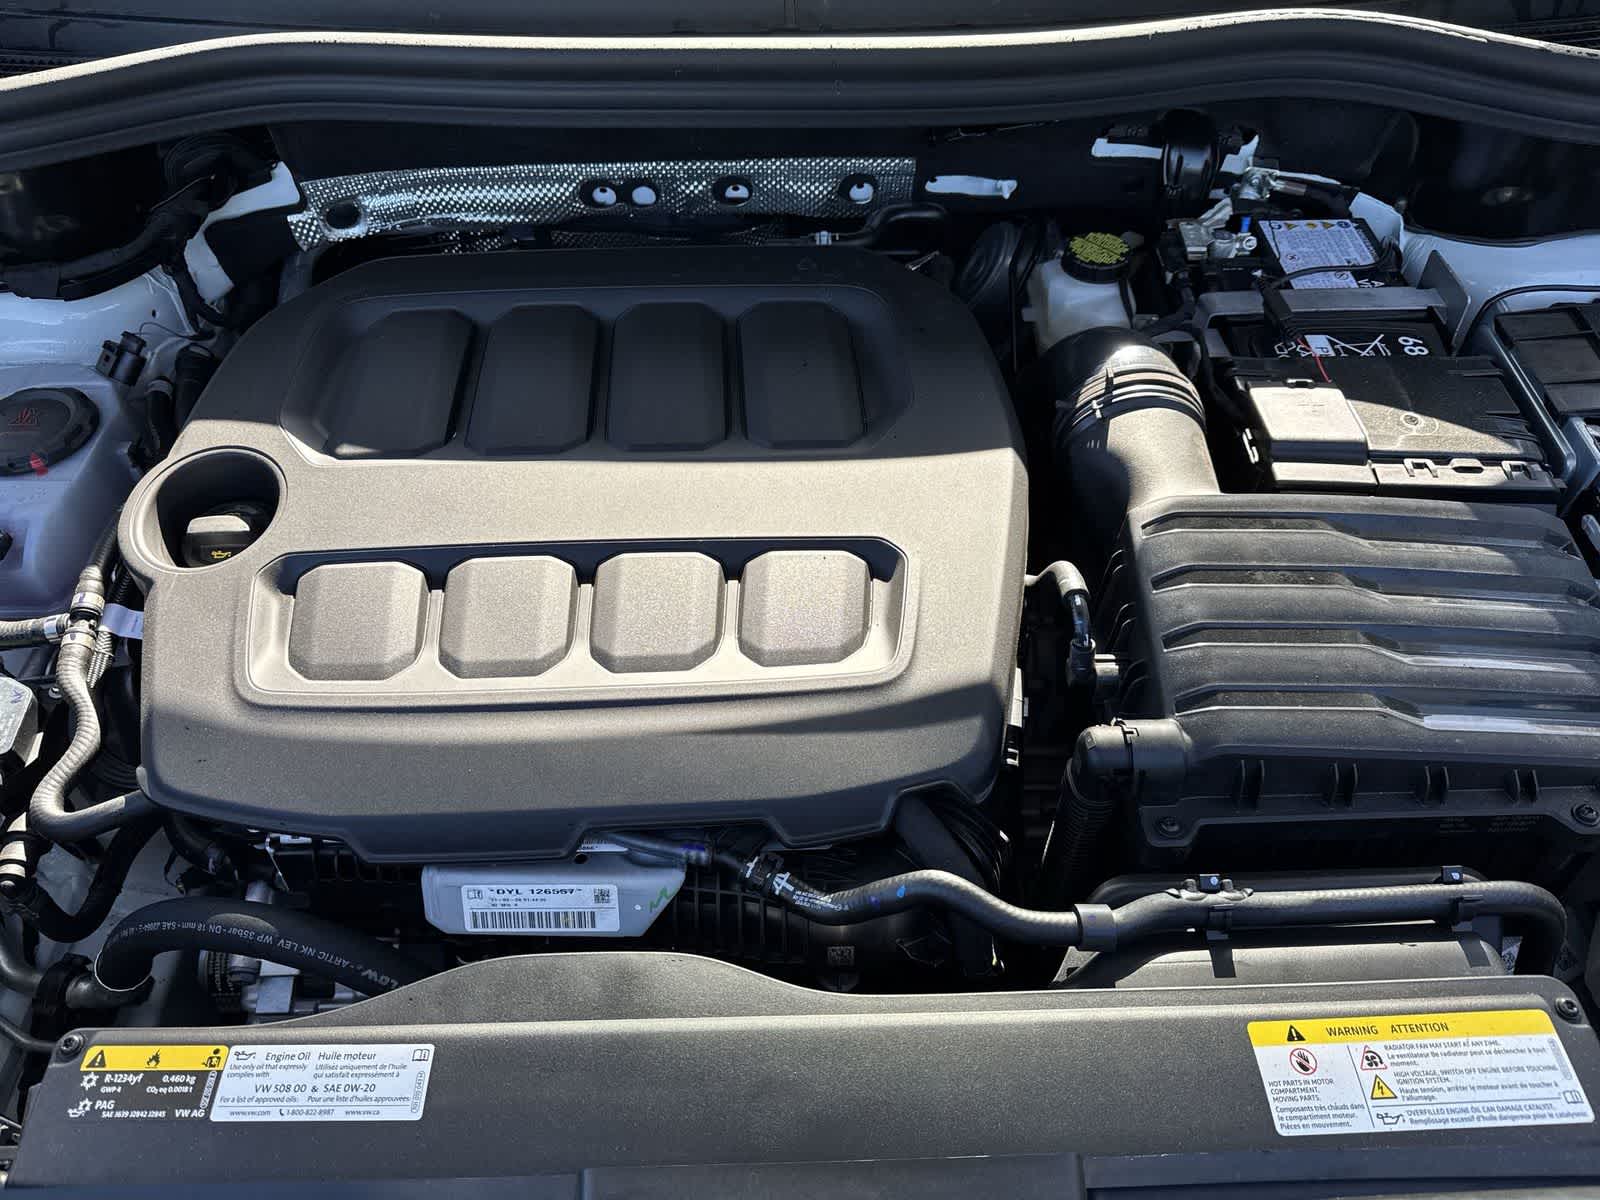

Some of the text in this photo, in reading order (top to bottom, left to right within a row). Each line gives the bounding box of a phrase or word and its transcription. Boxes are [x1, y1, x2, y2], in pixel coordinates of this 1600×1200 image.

[1398, 335, 1429, 356] 68
[161, 921, 177, 930] SAE
[182, 921, 196, 929] mm
[209, 922, 222, 934] DN
[256, 935, 273, 945] WP
[277, 938, 300, 951] LEV
[302, 945, 315, 957] NK
[317, 952, 350, 969] ARTIC
[1326, 1022, 1450, 1037] WARNING ATTENTION
[265, 1051, 376, 1063] Engine Oil Huile moteur
[242, 1063, 255, 1071] only
[279, 1063, 307, 1071] expressly
[340, 1064, 379, 1072] uniquement
[104, 1073, 197, 1085] R-1234yf 0.460 kg
[313, 1072, 324, 1080] qui
[255, 1083, 376, 1093] VW 508 00 & SAE 0W-20
[1270, 1087, 1320, 1095] COMPARTMENT.
[220, 1095, 231, 1103] For
[236, 1095, 247, 1103] list
[248, 1095, 255, 1103] of
[255, 1095, 285, 1104] approved
[1272, 1094, 1320, 1103] MOVING PARTS.
[94, 1100, 115, 1110] PAG
[1275, 1105, 1314, 1113] Composants
[1327, 1102, 1349, 1110] chauds
[1350, 1102, 1365, 1110] dans
[175, 1109, 205, 1117] VW AG
[1286, 1113, 1331, 1121] compartiment
[1280, 1122, 1301, 1130] Pièces
[1312, 1121, 1353, 1129] mouvement.
